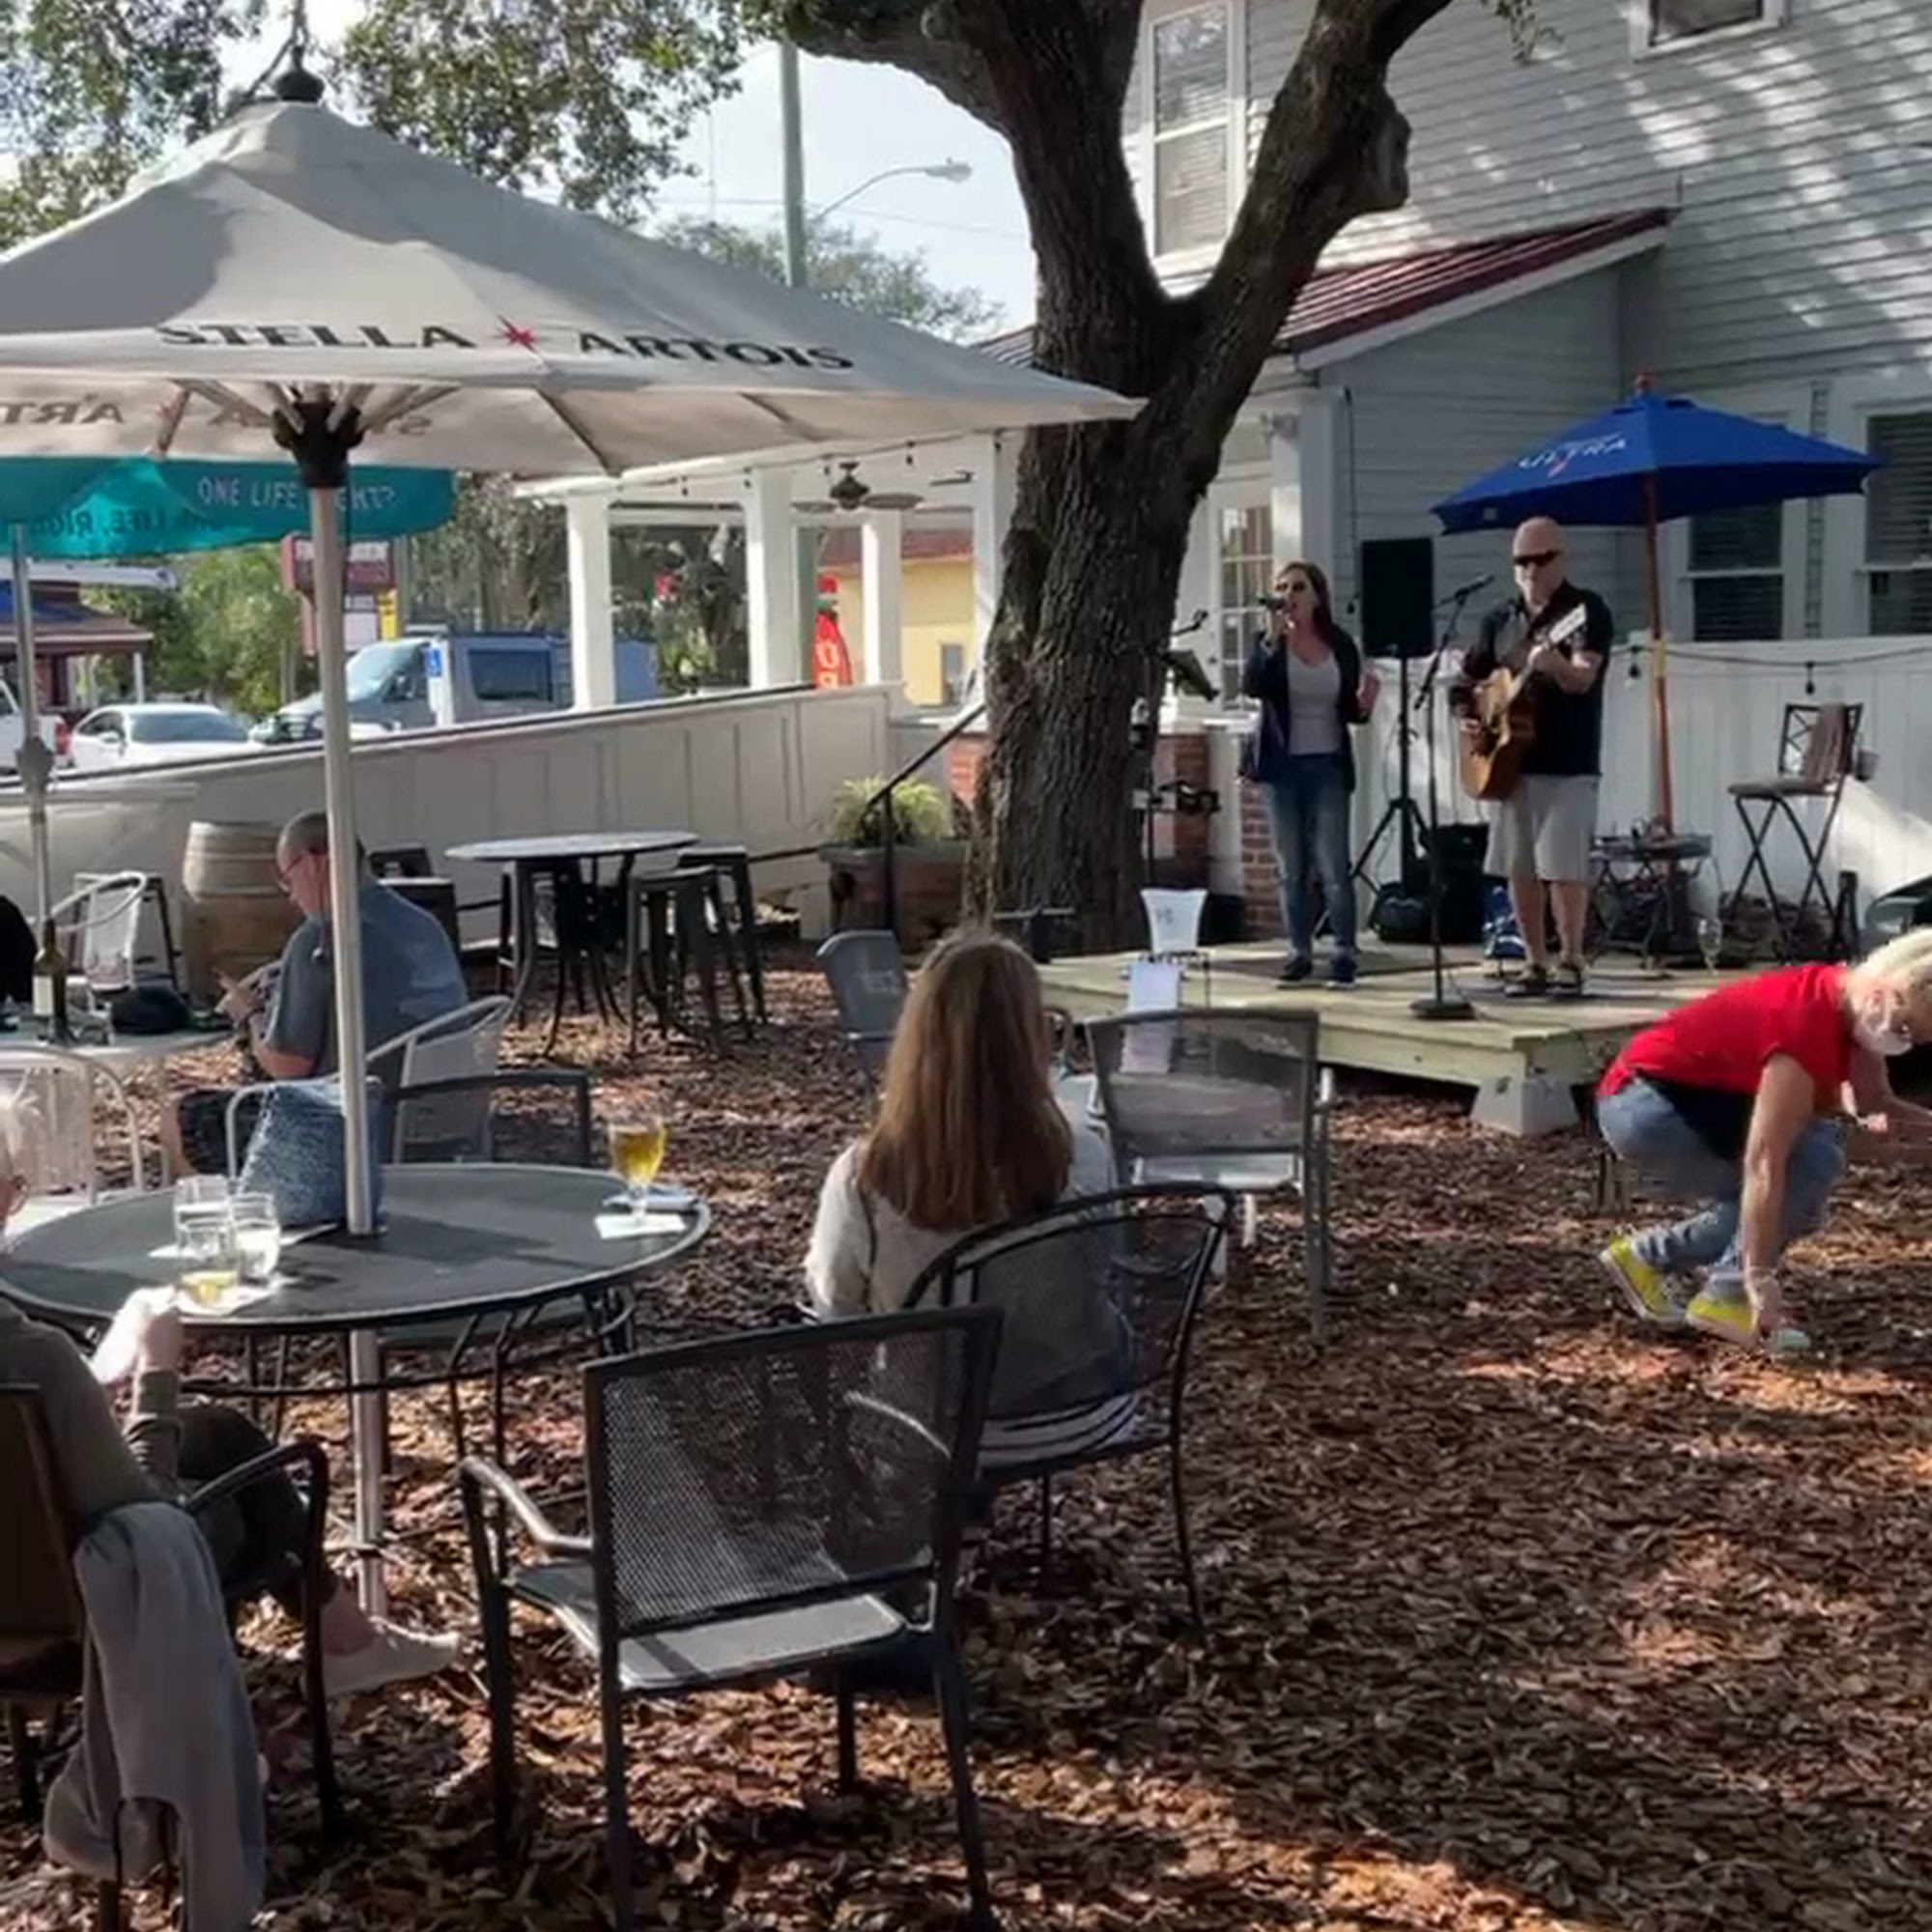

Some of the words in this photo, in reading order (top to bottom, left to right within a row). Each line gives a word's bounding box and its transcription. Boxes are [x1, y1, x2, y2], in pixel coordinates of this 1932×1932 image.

[156, 326, 477, 348] STELLA
[579, 332, 854, 368] ARTOIS
[198, 477, 240, 506] ONE
